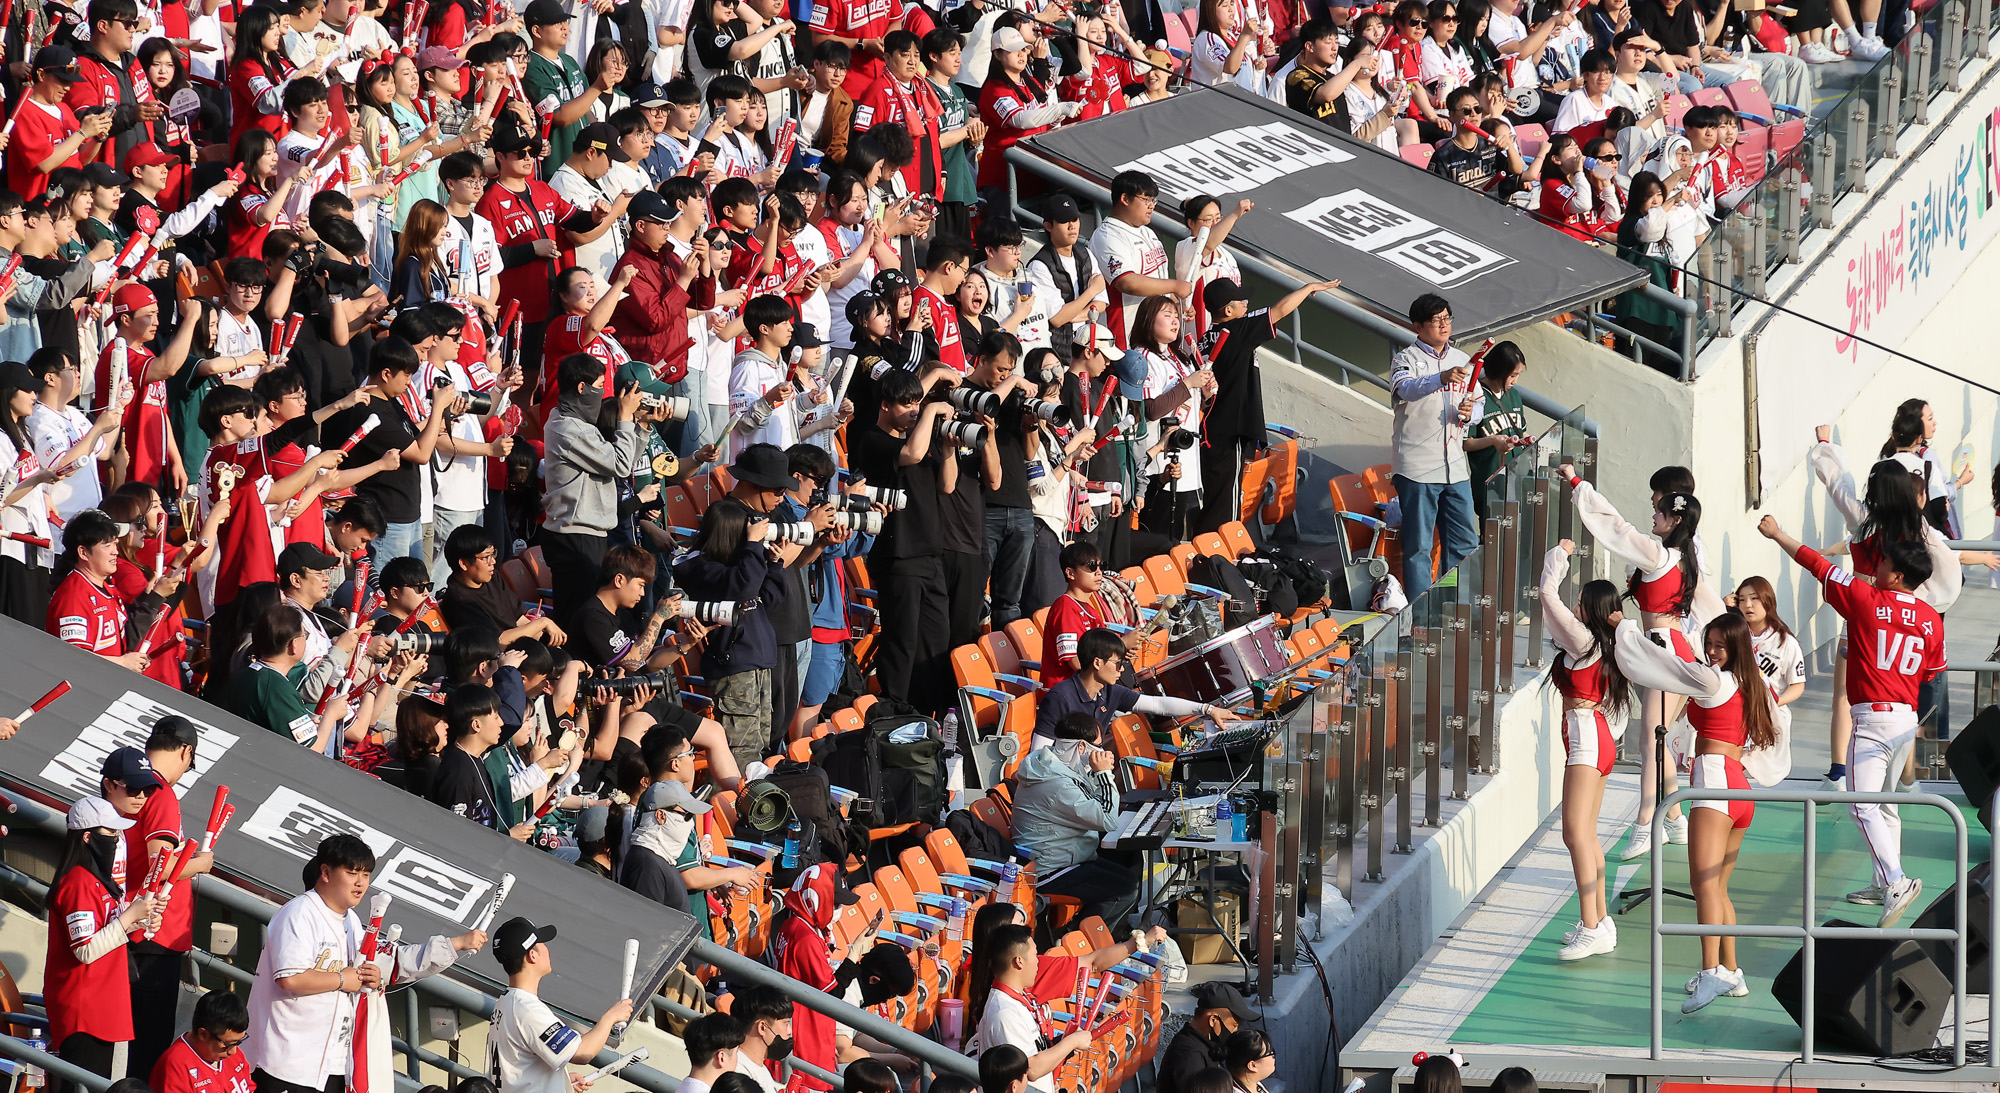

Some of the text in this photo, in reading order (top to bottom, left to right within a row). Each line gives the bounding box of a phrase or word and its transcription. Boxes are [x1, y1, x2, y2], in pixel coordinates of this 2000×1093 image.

[1148, 131, 1332, 199] MEGABOX
[1308, 200, 1412, 242] MEGA
[1400, 239, 1482, 277] LED
[61, 628, 86, 639] emart
[1876, 629, 1925, 676] V6
[69, 922, 94, 937] emart
